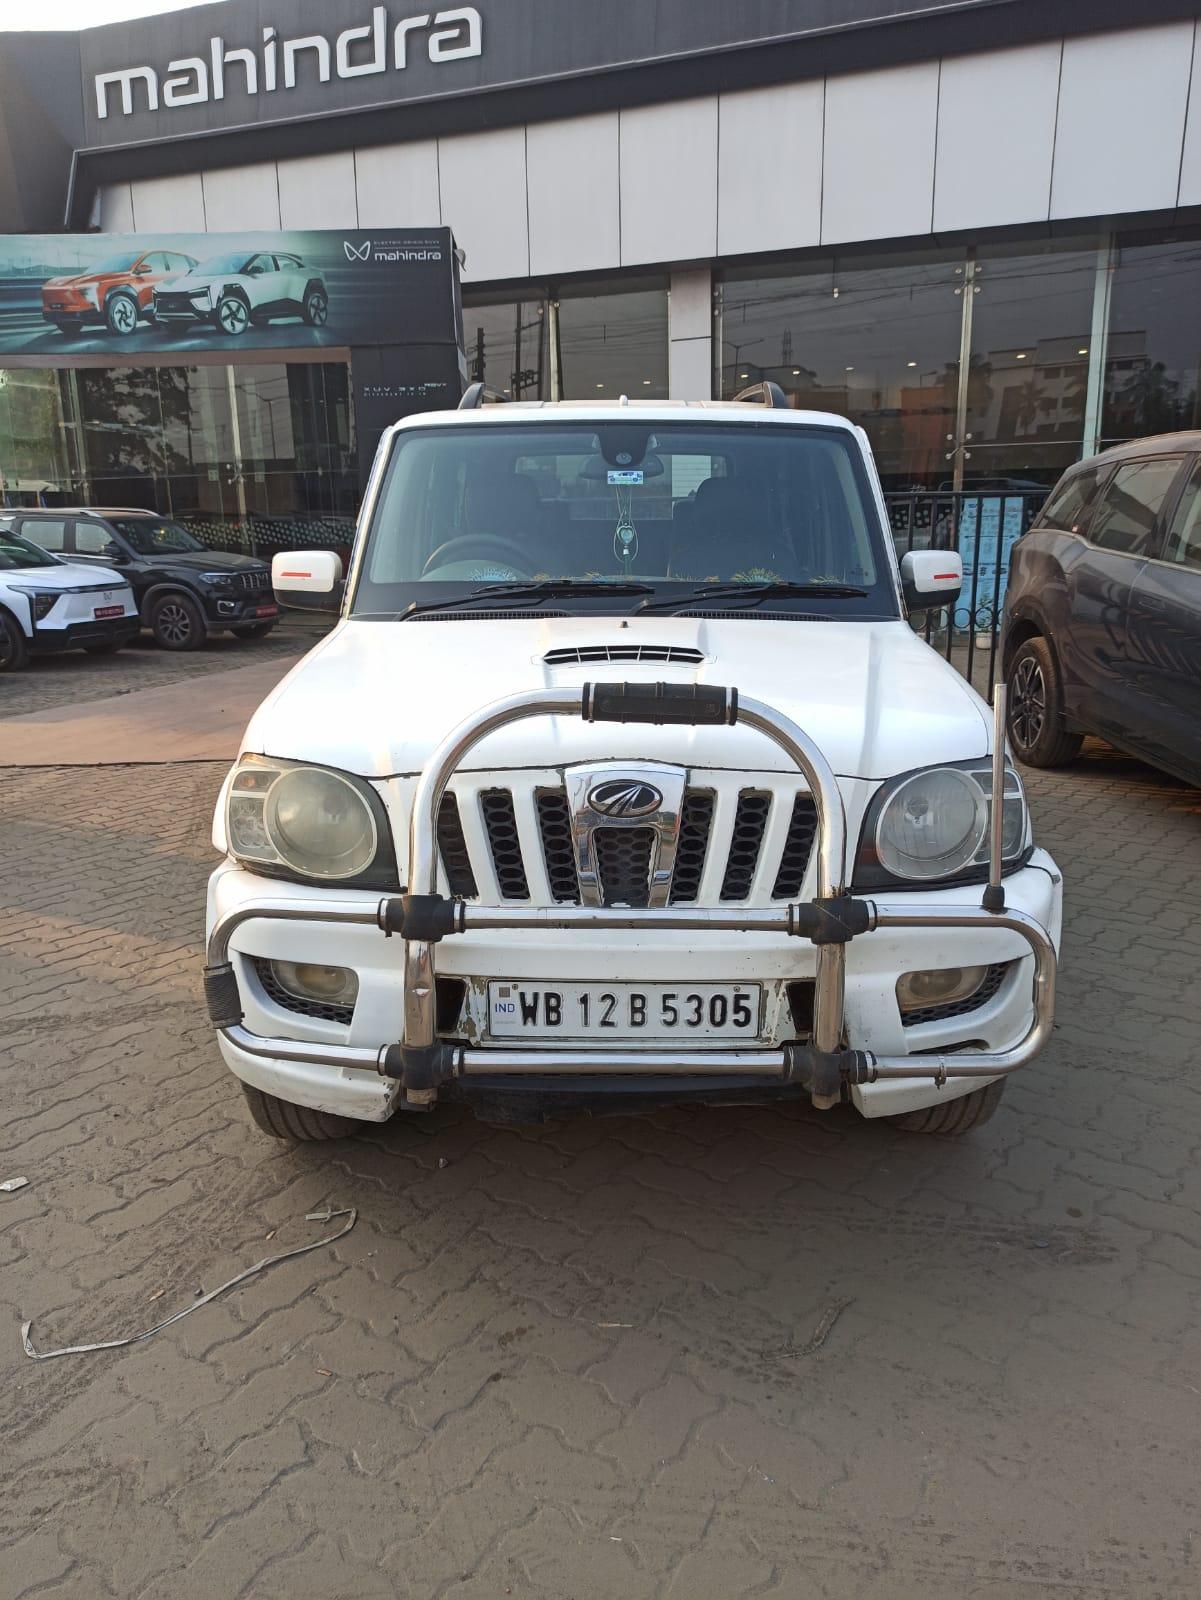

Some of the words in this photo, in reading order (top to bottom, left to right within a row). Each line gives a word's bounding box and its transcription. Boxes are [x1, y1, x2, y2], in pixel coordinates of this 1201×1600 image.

[95, 6, 482, 119] mahindra
[374, 250, 442, 261] mahindra
[494, 1003, 516, 1014] IND
[519, 991, 563, 1027] WB
[578, 992, 617, 1028] 12
[629, 993, 648, 1028] B
[660, 993, 752, 1028] 5305
